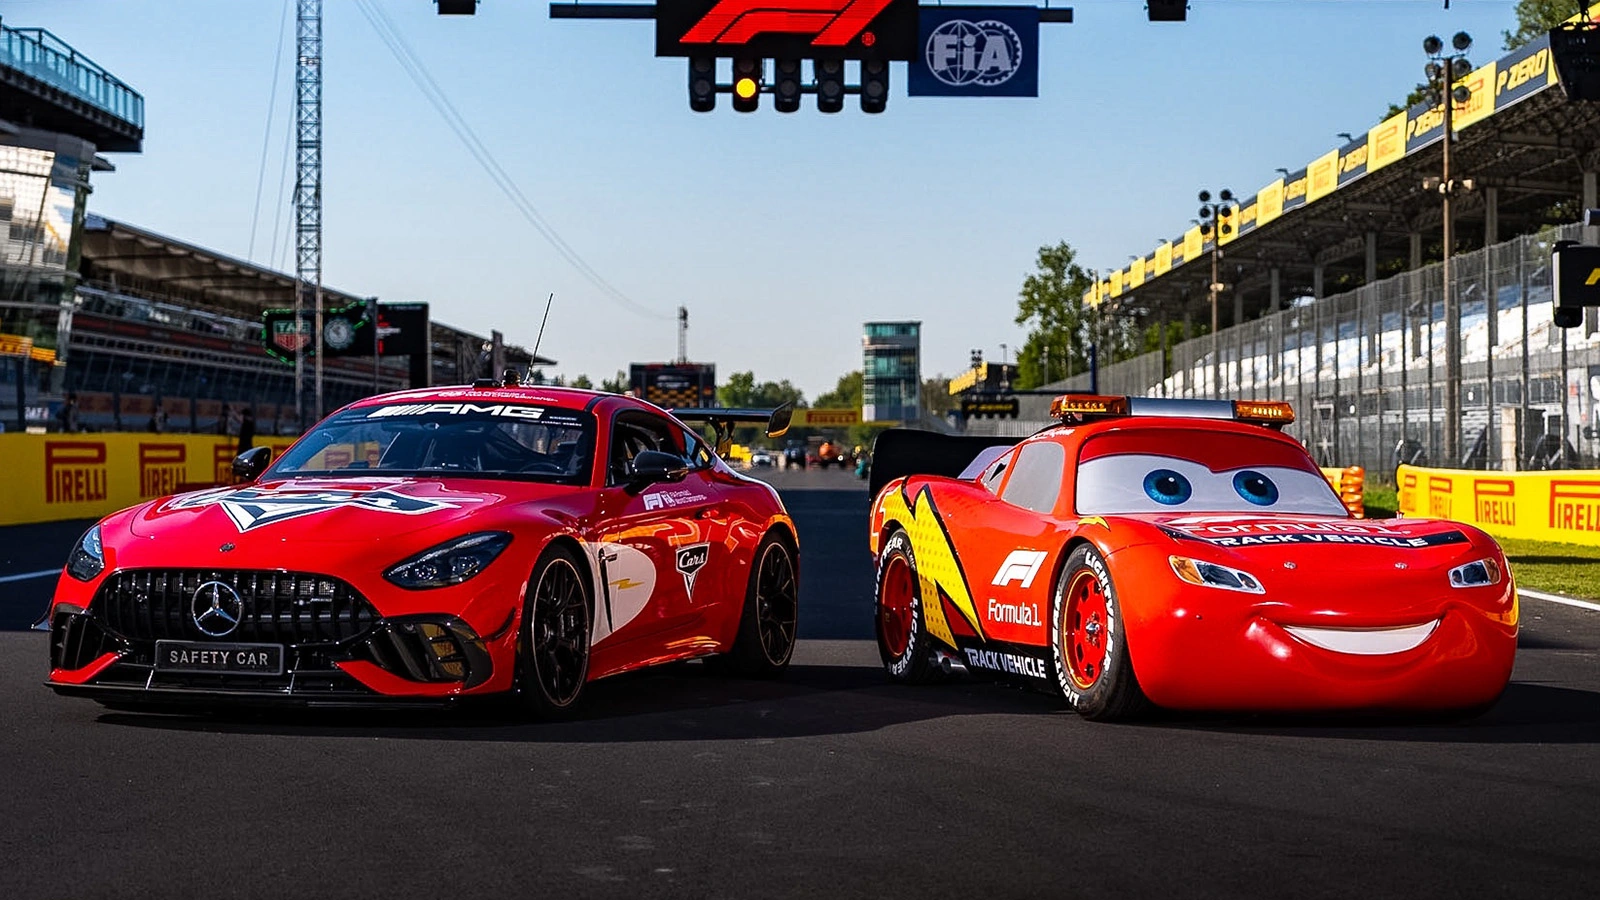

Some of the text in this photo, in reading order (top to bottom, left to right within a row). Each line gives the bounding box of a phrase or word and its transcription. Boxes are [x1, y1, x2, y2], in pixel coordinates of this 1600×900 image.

[1496, 48, 1548, 96] P ZERO
[417, 403, 545, 419] AMG
[45, 441, 107, 503] PIRELLI
[1474, 479, 1515, 526] PIRELLI
[1209, 534, 1428, 547] TRACK VEHICLE
[680, 551, 704, 568] Cars
[991, 549, 1049, 589] F1
[170, 650, 268, 665] SAFETY CAR
[964, 648, 1047, 679] TRACK VEHICLE
